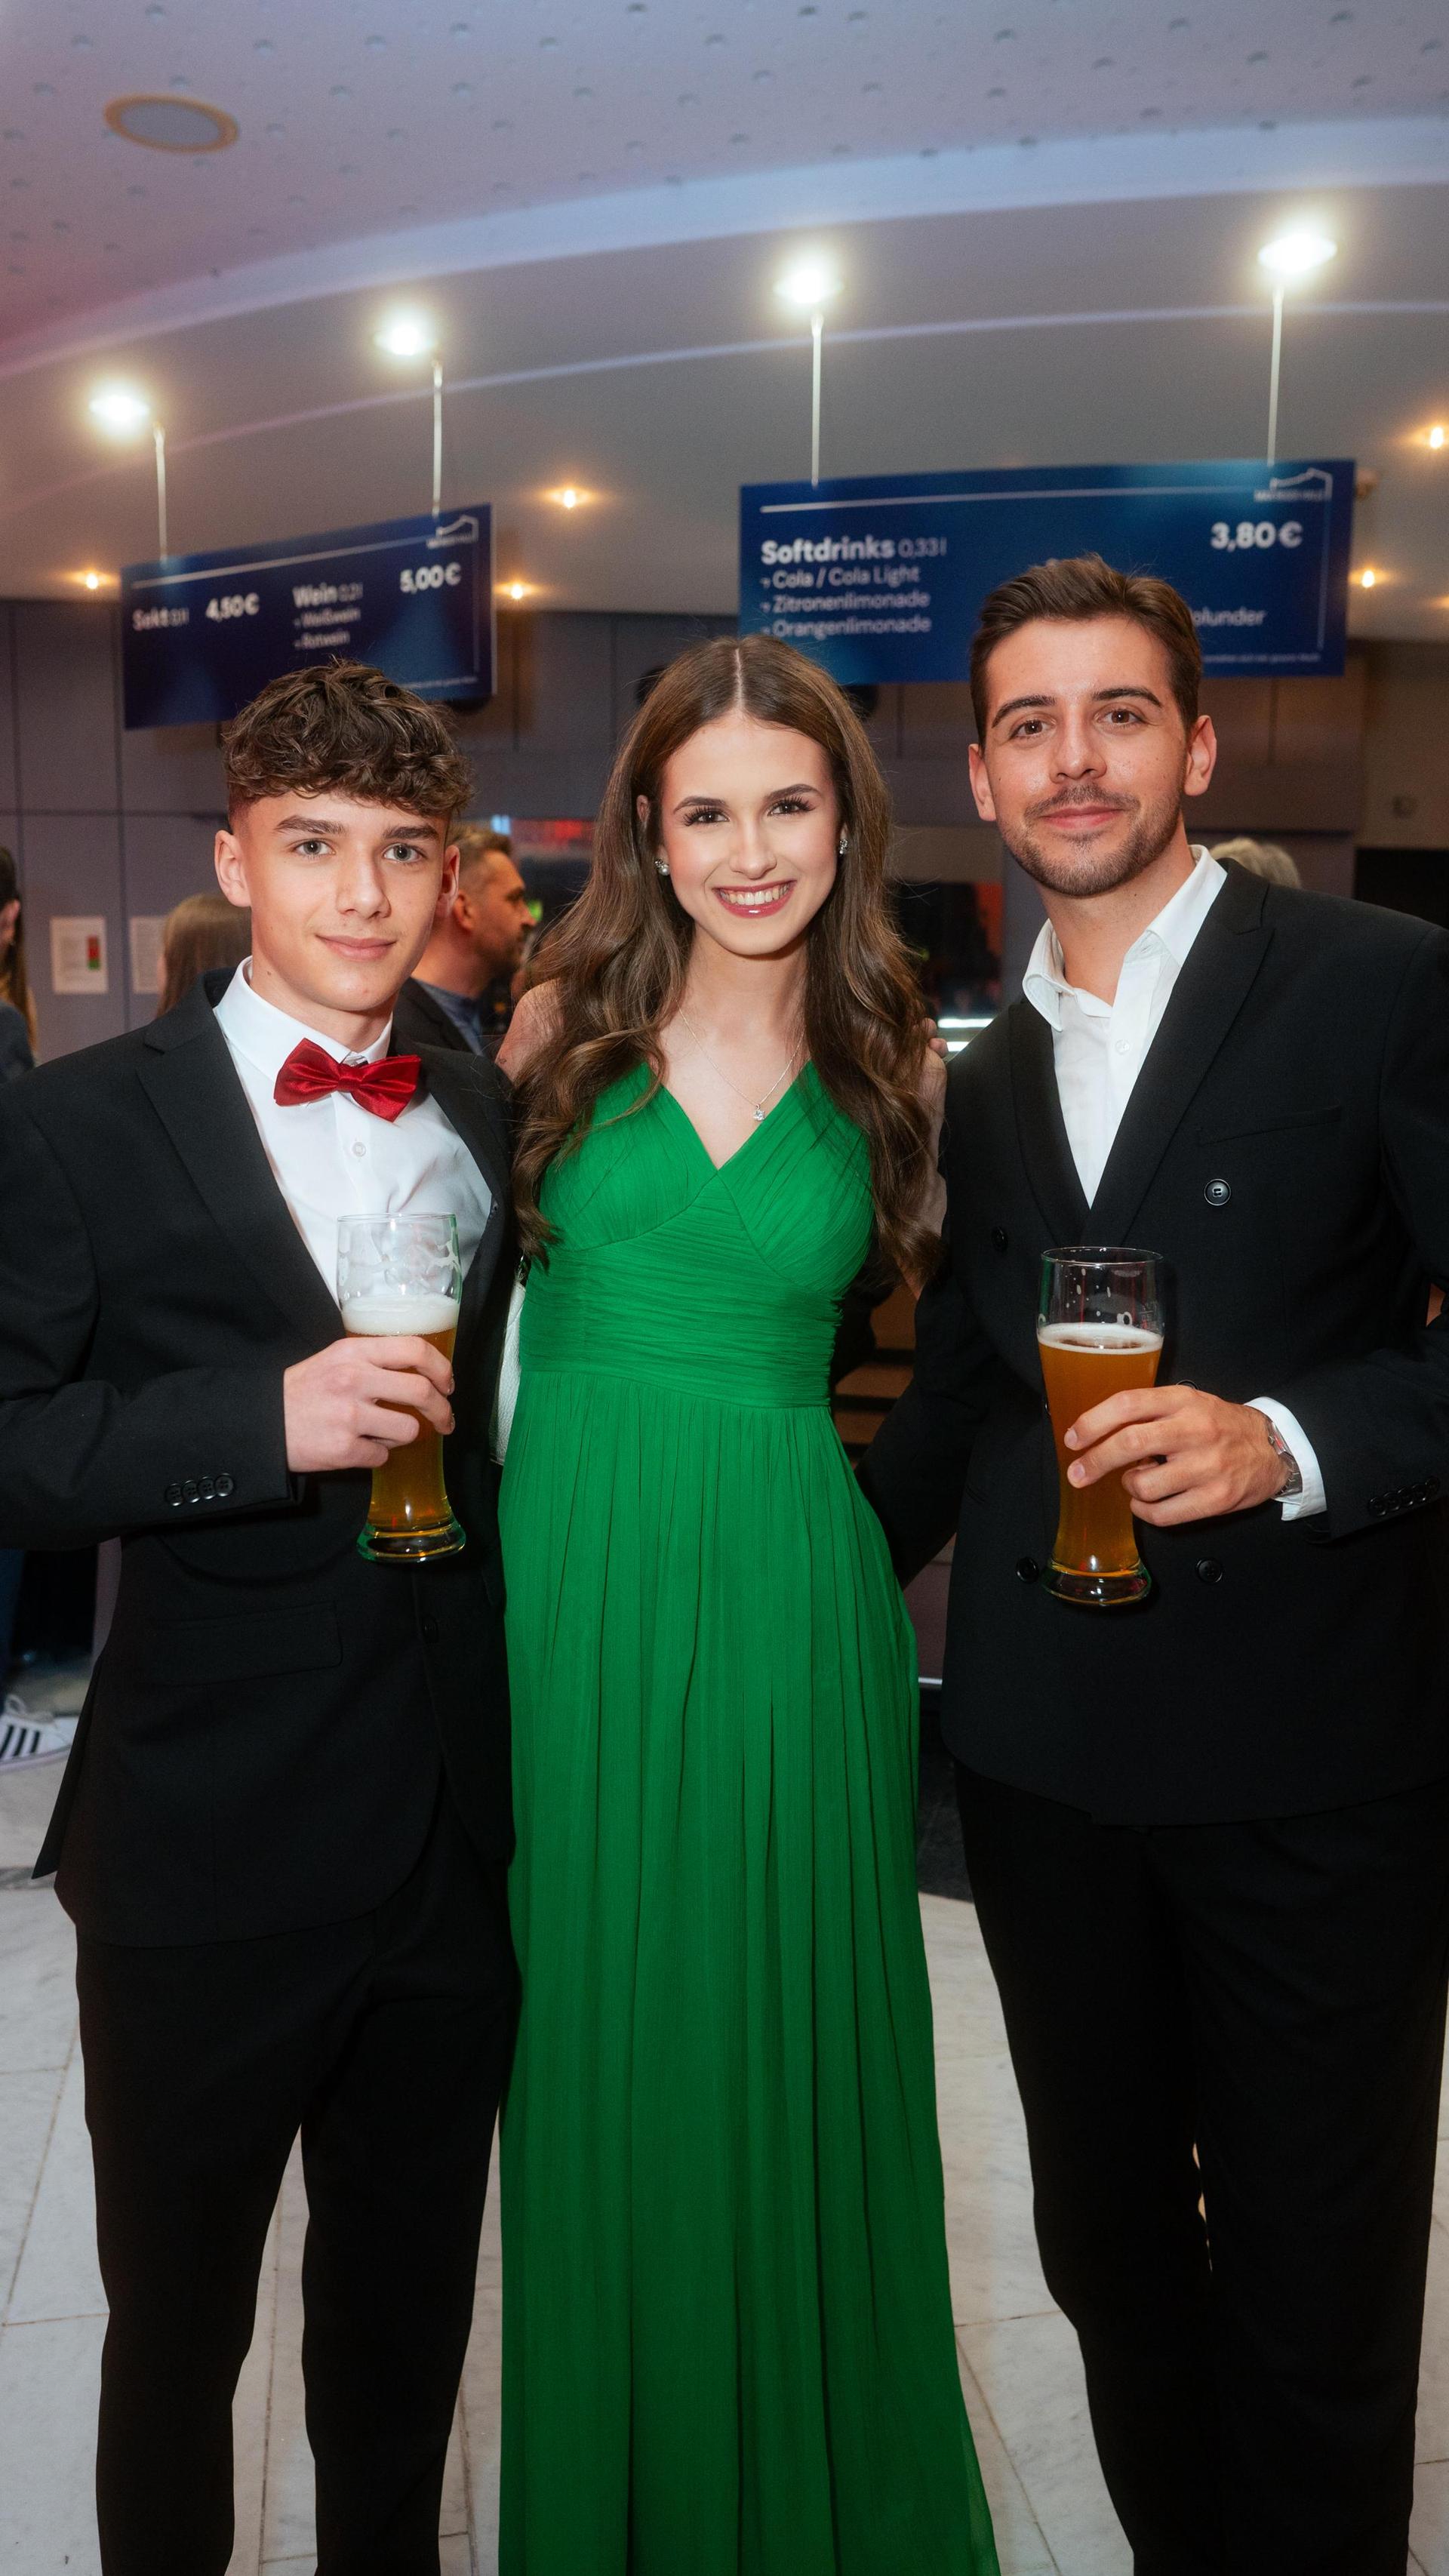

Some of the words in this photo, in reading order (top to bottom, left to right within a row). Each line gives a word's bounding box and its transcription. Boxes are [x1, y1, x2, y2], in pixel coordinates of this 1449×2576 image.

[761, 535, 895, 565] Softdrinks
[774, 570, 814, 589] Cola
[829, 568, 870, 586] Cola
[873, 565, 919, 586] Light
[293, 583, 337, 607] Wein
[774, 590, 931, 613] Zitronenlimonade
[774, 614, 931, 639] Orangenlimonade
[1192, 607, 1266, 626] olunder
